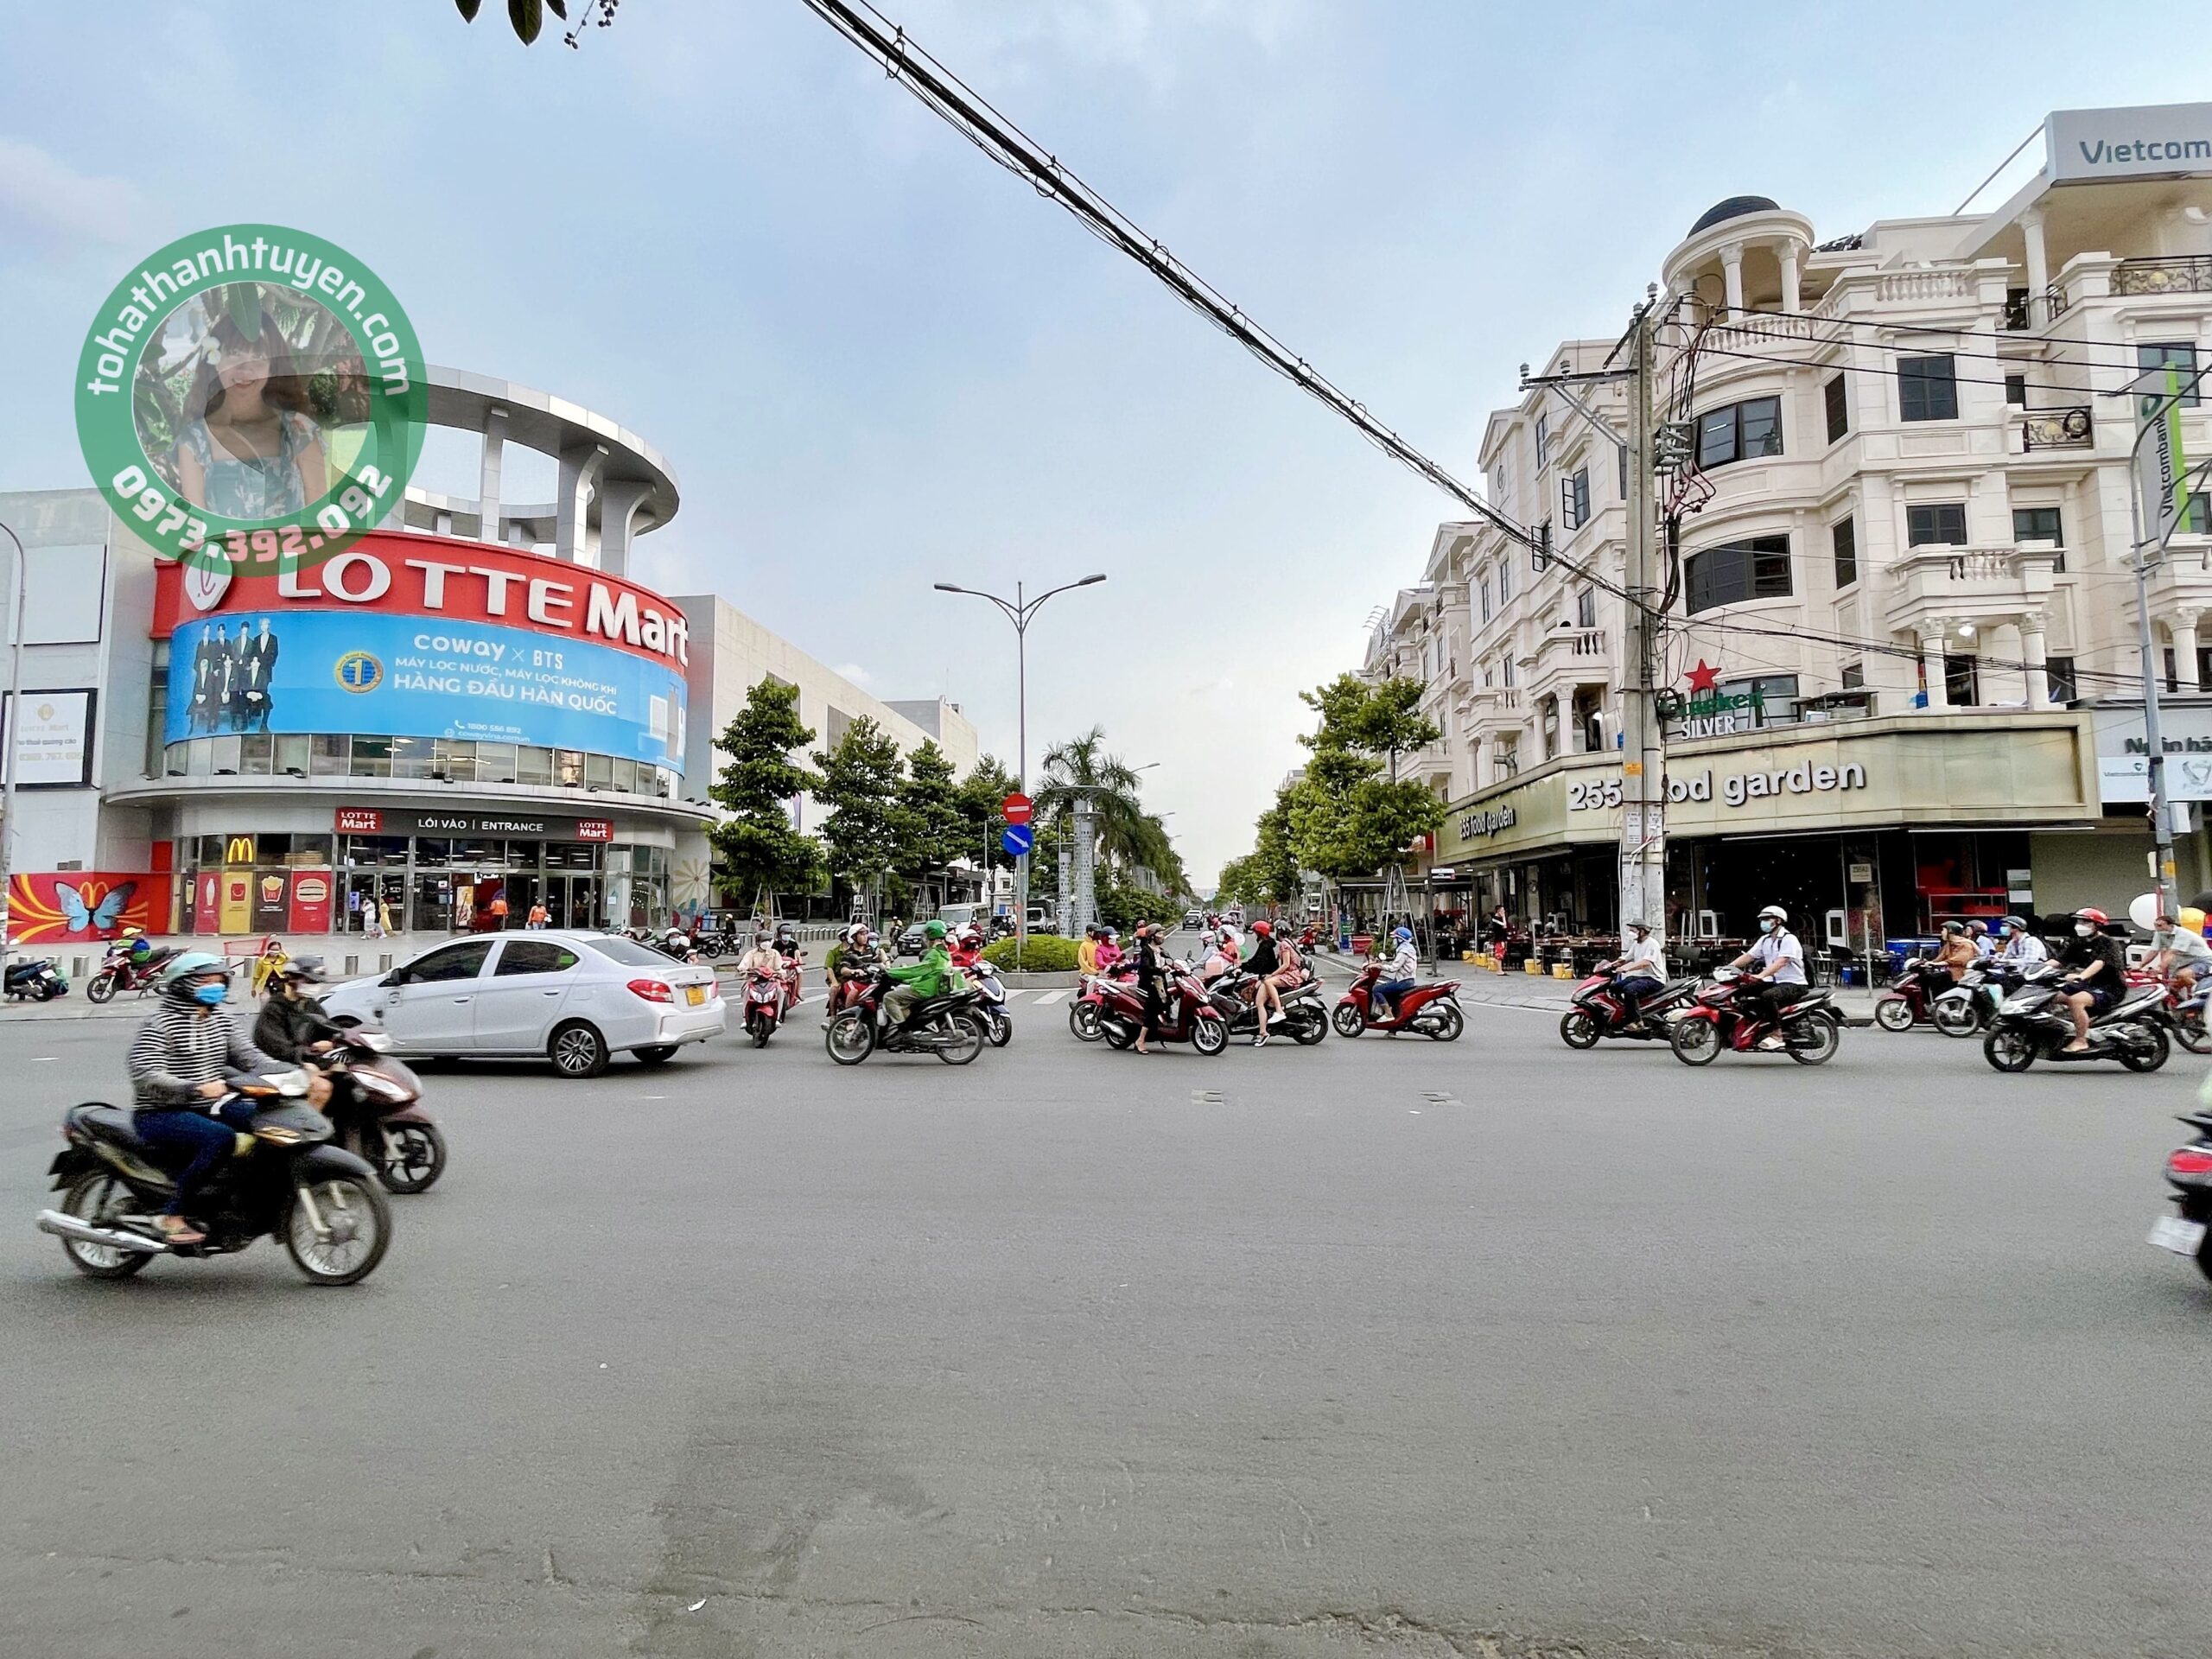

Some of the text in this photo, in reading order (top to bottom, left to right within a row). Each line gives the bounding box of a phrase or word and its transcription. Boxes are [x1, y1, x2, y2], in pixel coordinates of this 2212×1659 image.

[277, 551, 689, 668] LOTTE Mart
[395, 657, 426, 669] MÁY
[429, 659, 458, 672] LỌC
[505, 668, 533, 681] MÁY
[535, 672, 560, 685] LỌC
[533, 649, 563, 671] BTS
[394, 671, 461, 693] HÀNG
[520, 685, 563, 706] HÀN
[568, 694, 618, 715] QUỐC
[1681, 715, 1736, 741] SILVER
[1569, 779, 1623, 810] 255
[1724, 760, 1865, 806] garden
[340, 819, 376, 830] Mart
[481, 821, 544, 832] ENTRANCE
[579, 829, 607, 838] Mart
[1471, 810, 1486, 837] food
[1486, 804, 1515, 838] garden
